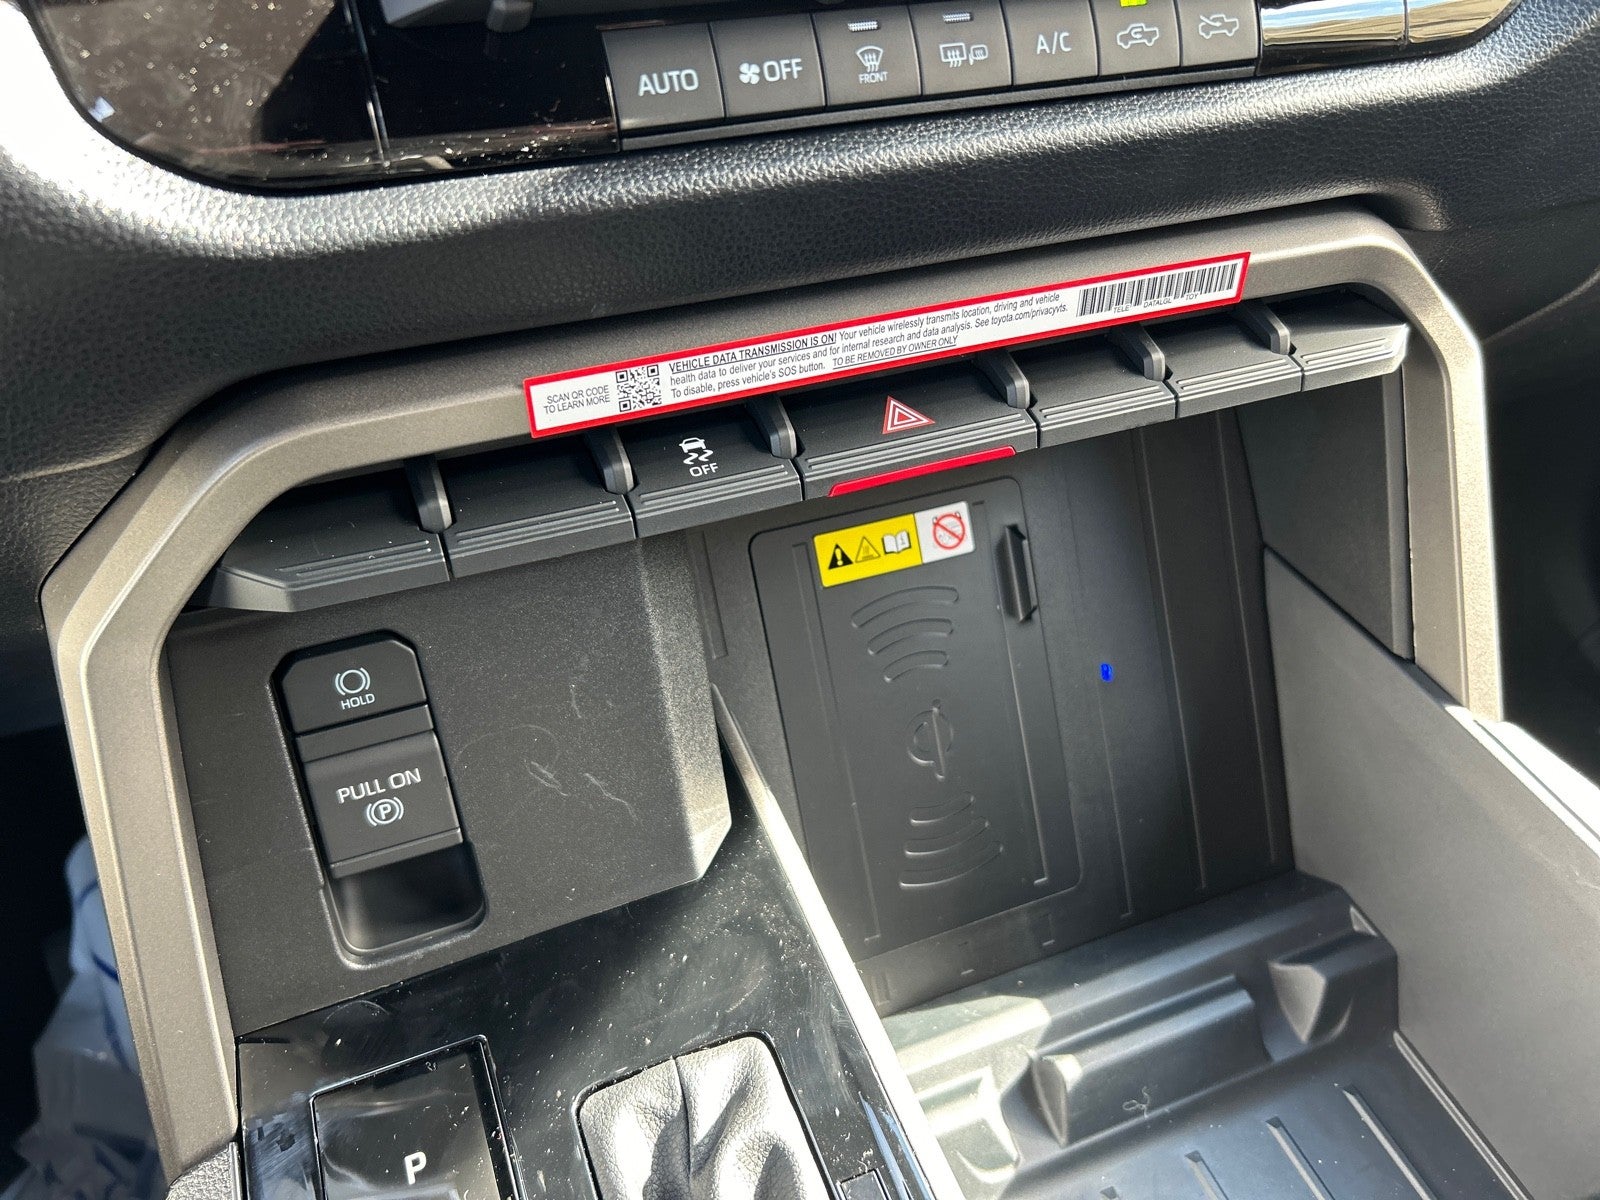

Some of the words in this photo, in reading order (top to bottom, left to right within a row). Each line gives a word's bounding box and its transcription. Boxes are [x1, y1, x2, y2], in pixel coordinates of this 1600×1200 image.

[1037, 32, 1072, 55] A/C
[763, 58, 803, 82] OFF
[859, 71, 888, 84] FRONT
[638, 69, 698, 96] AUTO
[1185, 292, 1199, 301] TOY
[669, 356, 711, 373] VEHICLE
[712, 352, 737, 364] DATA
[739, 338, 808, 359] TRANSMISSION
[810, 336, 819, 346] IS
[821, 333, 837, 344] ON!
[840, 330, 857, 341] Your
[859, 324, 886, 337] vehicle
[888, 318, 924, 332] wirelessly
[926, 311, 960, 325] transmits
[961, 305, 992, 319] location,
[994, 300, 1018, 313] driving
[1019, 297, 1033, 308] and
[1035, 293, 1060, 305] vehicle
[670, 373, 696, 386] health
[698, 368, 716, 380] data
[718, 367, 727, 377] to
[729, 362, 756, 374] deliver
[758, 359, 776, 371] your
[778, 353, 811, 366] services
[813, 346, 828, 358] and
[829, 345, 840, 356] for
[841, 340, 870, 353] internal
[872, 334, 905, 347] research
[906, 330, 921, 342] and
[922, 327, 939, 338] data
[941, 320, 973, 335] analysis.
[975, 316, 990, 328] See
[833, 357, 844, 367] TO
[845, 354, 856, 364] BE
[857, 347, 896, 361] REMOVED
[897, 344, 908, 354] BY
[908, 338, 937, 352] OWNER
[938, 335, 958, 346] ONLY
[671, 388, 682, 398] To
[683, 381, 716, 396] disable,
[717, 377, 740, 391] press
[742, 370, 776, 384] vehicle's
[778, 366, 797, 377] SOS
[799, 361, 826, 374] button.
[544, 405, 556, 414] TO
[557, 400, 585, 412] LEARN
[586, 394, 610, 406] MORE
[547, 392, 570, 405] SCAN
[571, 389, 584, 400] QR
[586, 385, 609, 397] CODE
[689, 462, 719, 477] OFF
[341, 693, 375, 710] HOLD
[336, 779, 386, 804] PULL
[388, 767, 422, 790] ON
[404, 1151, 427, 1185] P
